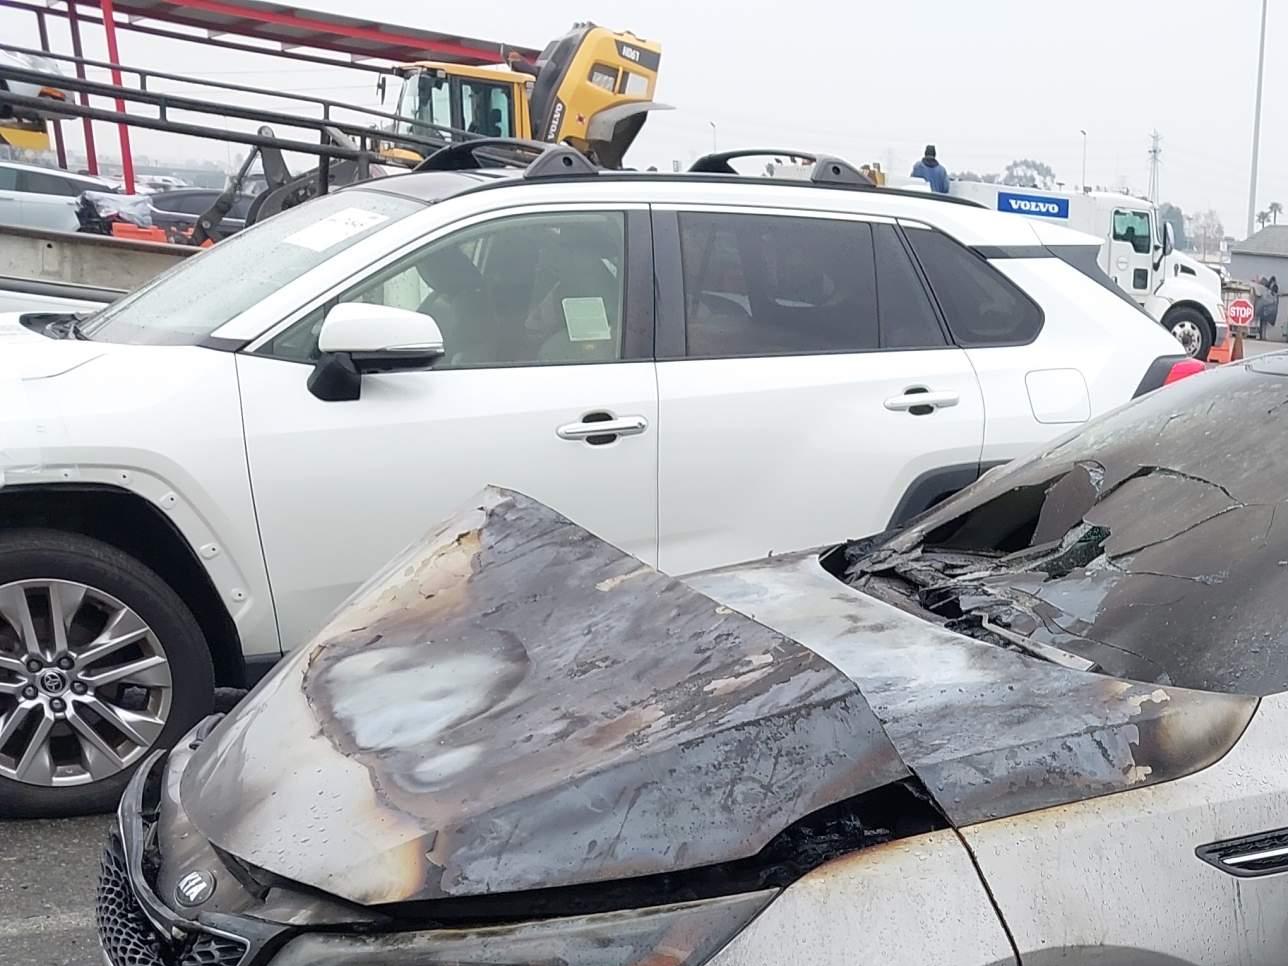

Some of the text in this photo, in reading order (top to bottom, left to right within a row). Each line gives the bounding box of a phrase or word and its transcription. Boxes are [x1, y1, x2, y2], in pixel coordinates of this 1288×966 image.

[547, 102, 564, 140] VOLVO
[1008, 199, 1059, 213] VOLVO
[1230, 306, 1251, 318] STOP
[178, 871, 207, 902] KIA
